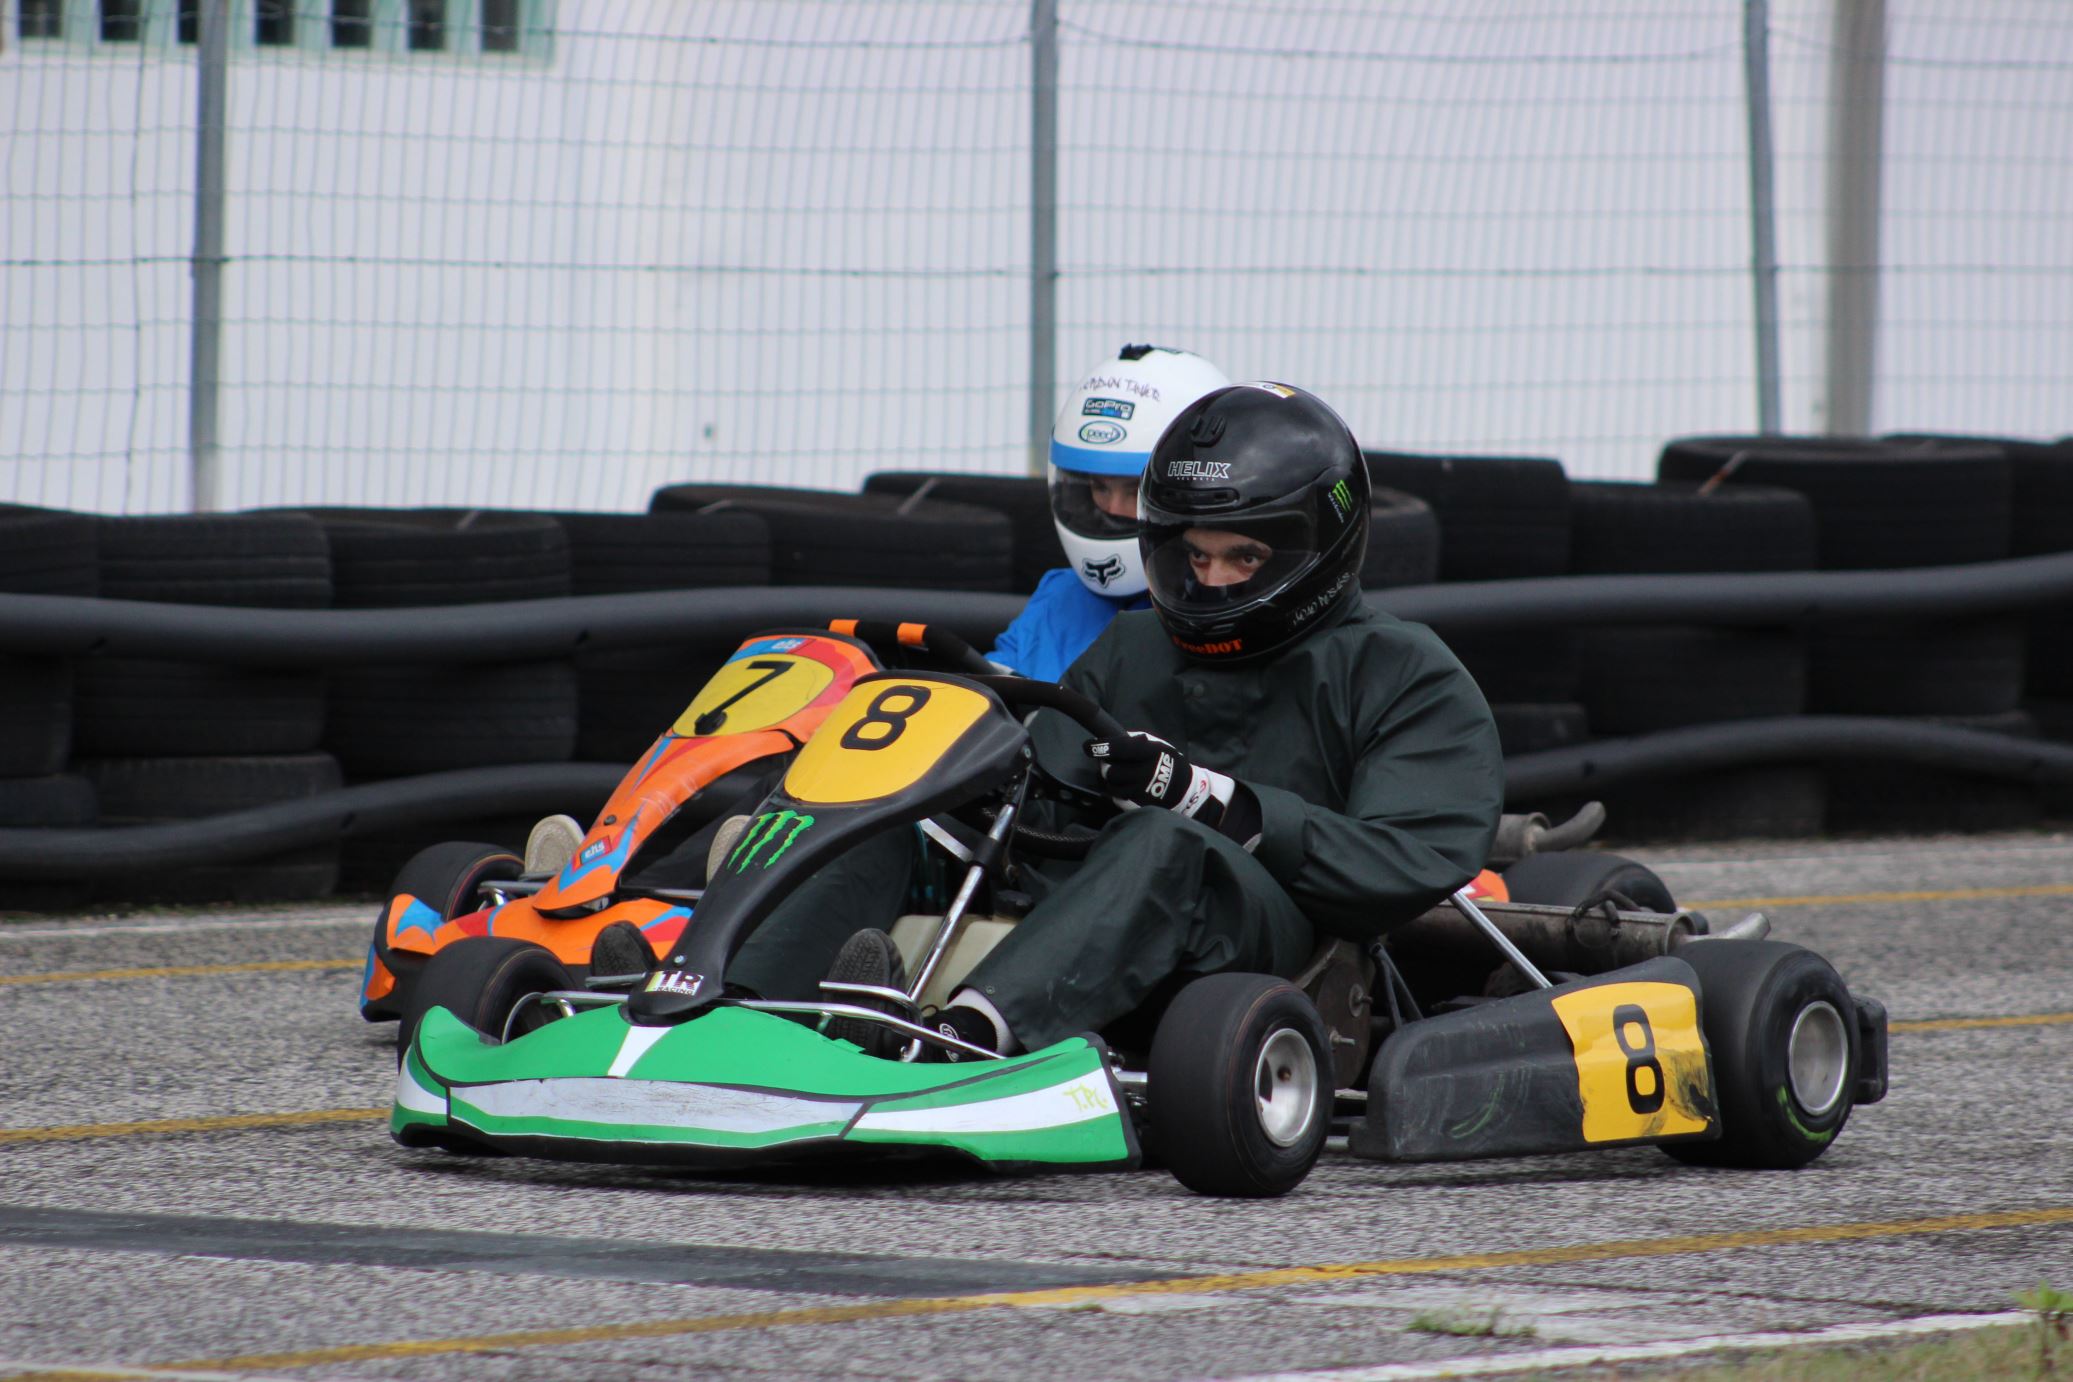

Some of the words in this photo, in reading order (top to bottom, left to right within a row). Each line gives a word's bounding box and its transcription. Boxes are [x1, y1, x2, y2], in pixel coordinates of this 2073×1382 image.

[1085, 399, 1132, 412] GoPro
[1167, 460, 1232, 479] HELIX
[694, 660, 796, 736] 7
[840, 684, 931, 751] 8
[1091, 744, 1110, 754] OMP
[1150, 753, 1171, 798] OMP
[660, 970, 703, 989] TR
[1612, 1003, 1666, 1115] 8
